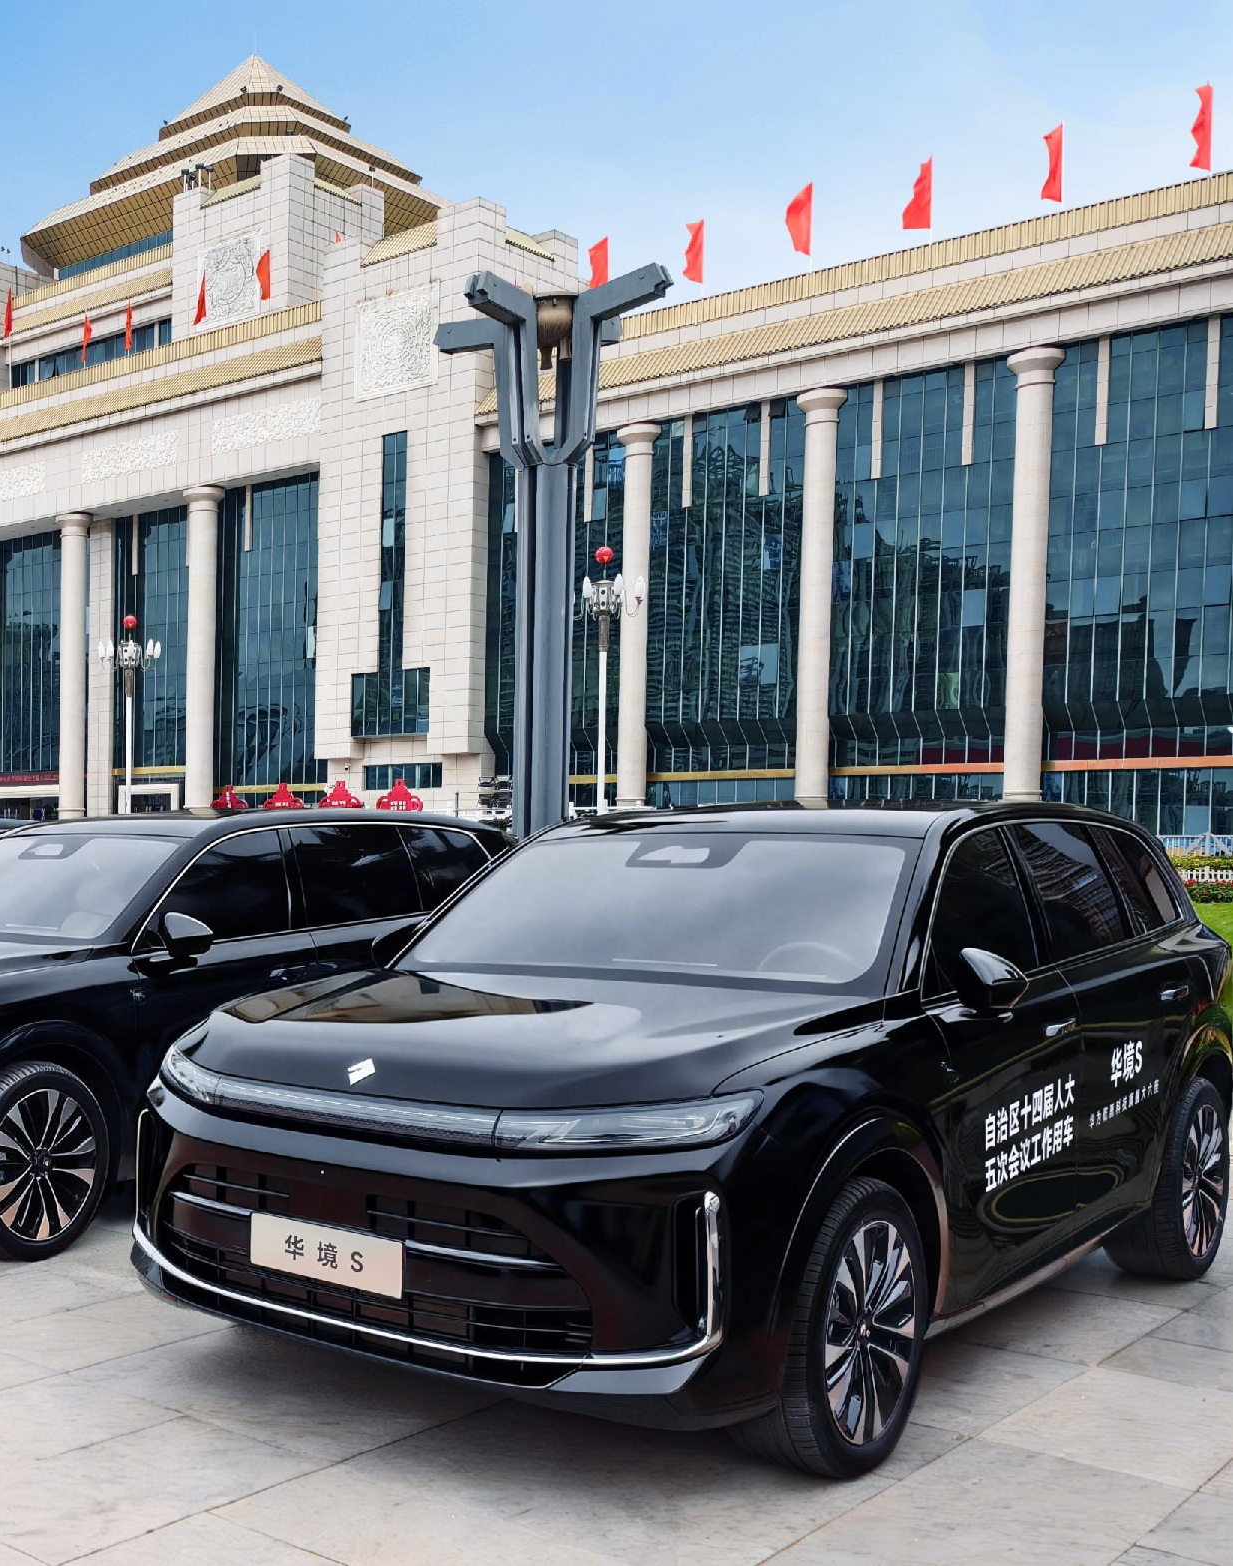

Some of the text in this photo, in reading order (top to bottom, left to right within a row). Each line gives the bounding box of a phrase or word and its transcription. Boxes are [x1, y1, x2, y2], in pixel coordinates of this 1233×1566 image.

[1110, 1040, 1143, 1088] 华境S
[985, 1073, 1076, 1151] 自治区十四届人大
[985, 1115, 1074, 1193] 五次会议工作用车
[284, 1234, 364, 1273] 华境S
